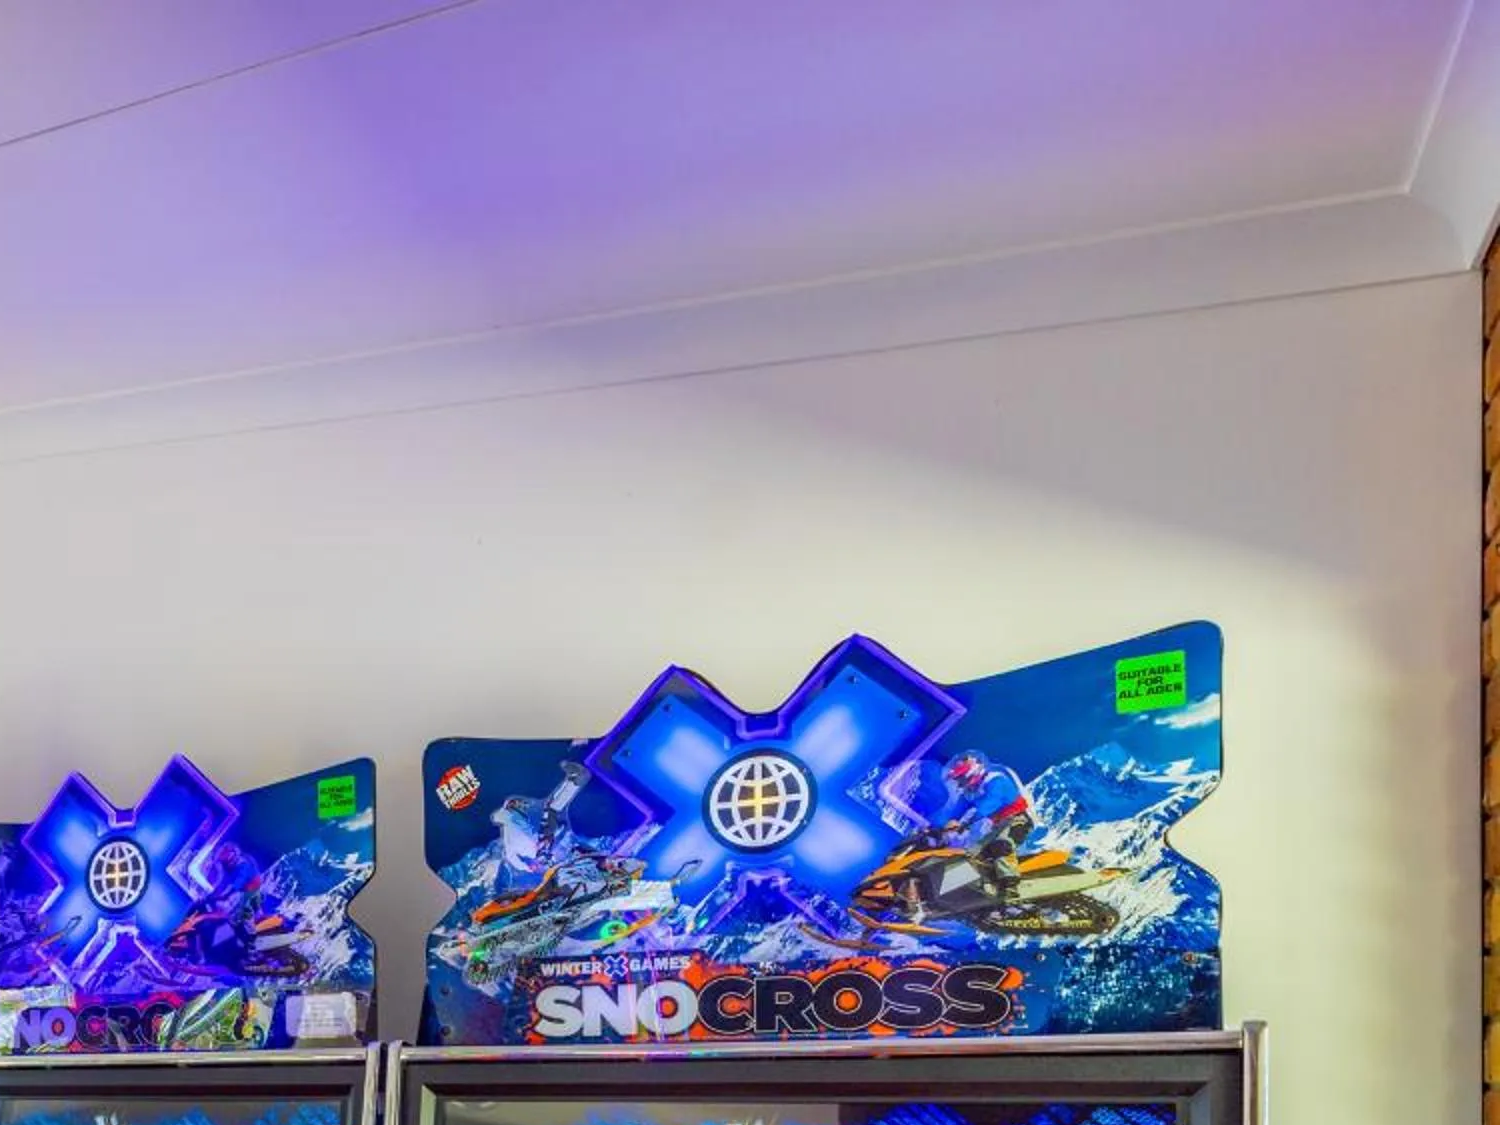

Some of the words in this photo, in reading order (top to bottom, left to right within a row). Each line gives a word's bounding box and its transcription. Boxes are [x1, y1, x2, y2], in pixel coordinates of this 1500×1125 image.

[1118, 663, 1182, 680] SUITABLE
[1137, 675, 1164, 687] FOR
[1118, 689, 1141, 699] ALL
[1146, 682, 1182, 695] AGES
[436, 765, 475, 800] RAW
[540, 960, 602, 978] WINTER
[630, 955, 692, 973] GAMES
